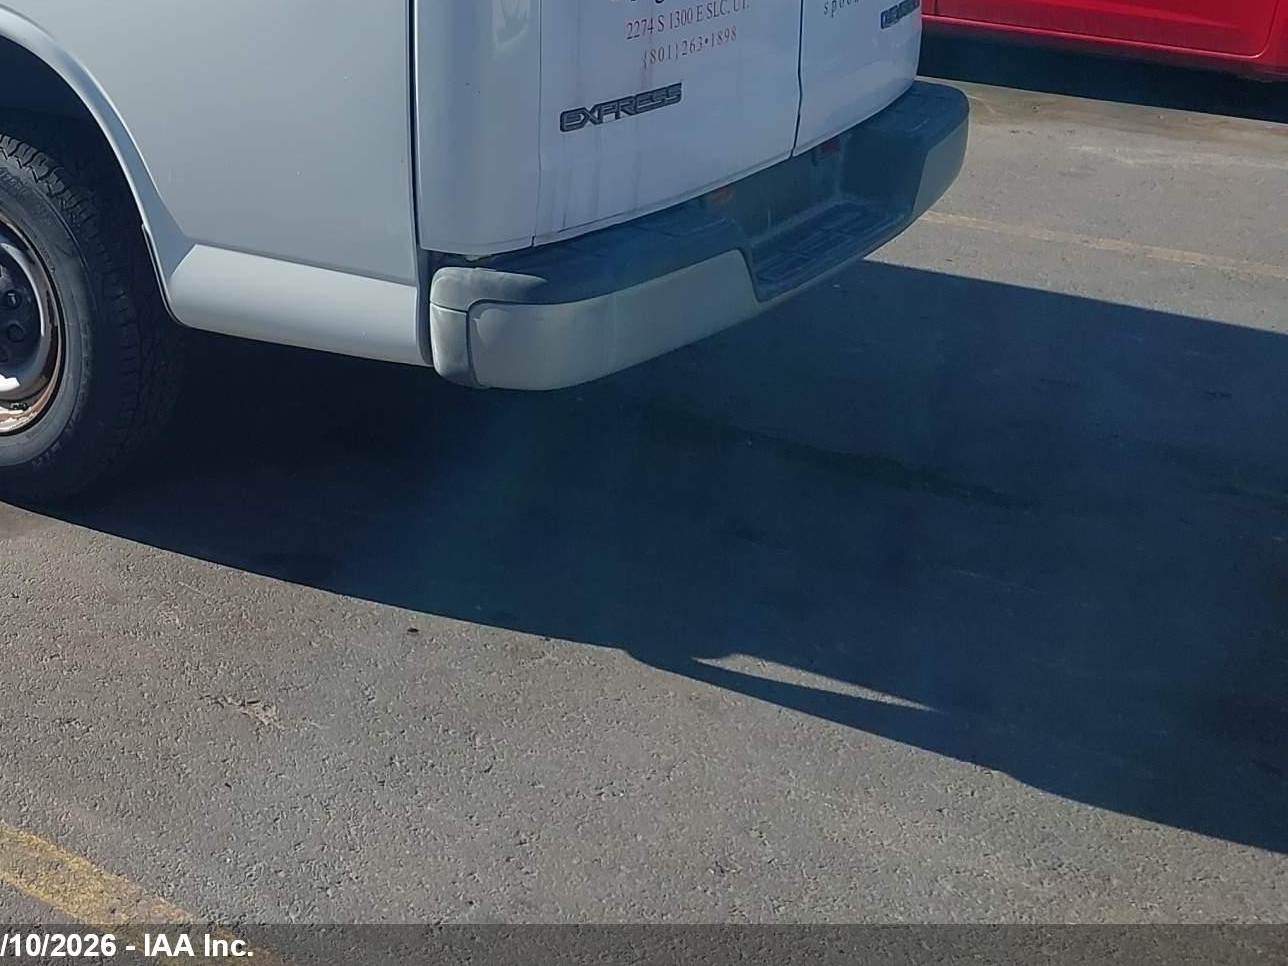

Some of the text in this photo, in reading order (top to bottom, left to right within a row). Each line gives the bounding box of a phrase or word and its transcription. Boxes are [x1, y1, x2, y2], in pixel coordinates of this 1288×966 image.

[626, 18, 655, 40] 2274
[656, 14, 665, 32] S
[669, 7, 693, 30] 1300
[696, 3, 705, 22] E
[559, 82, 683, 133] EXPRESS
